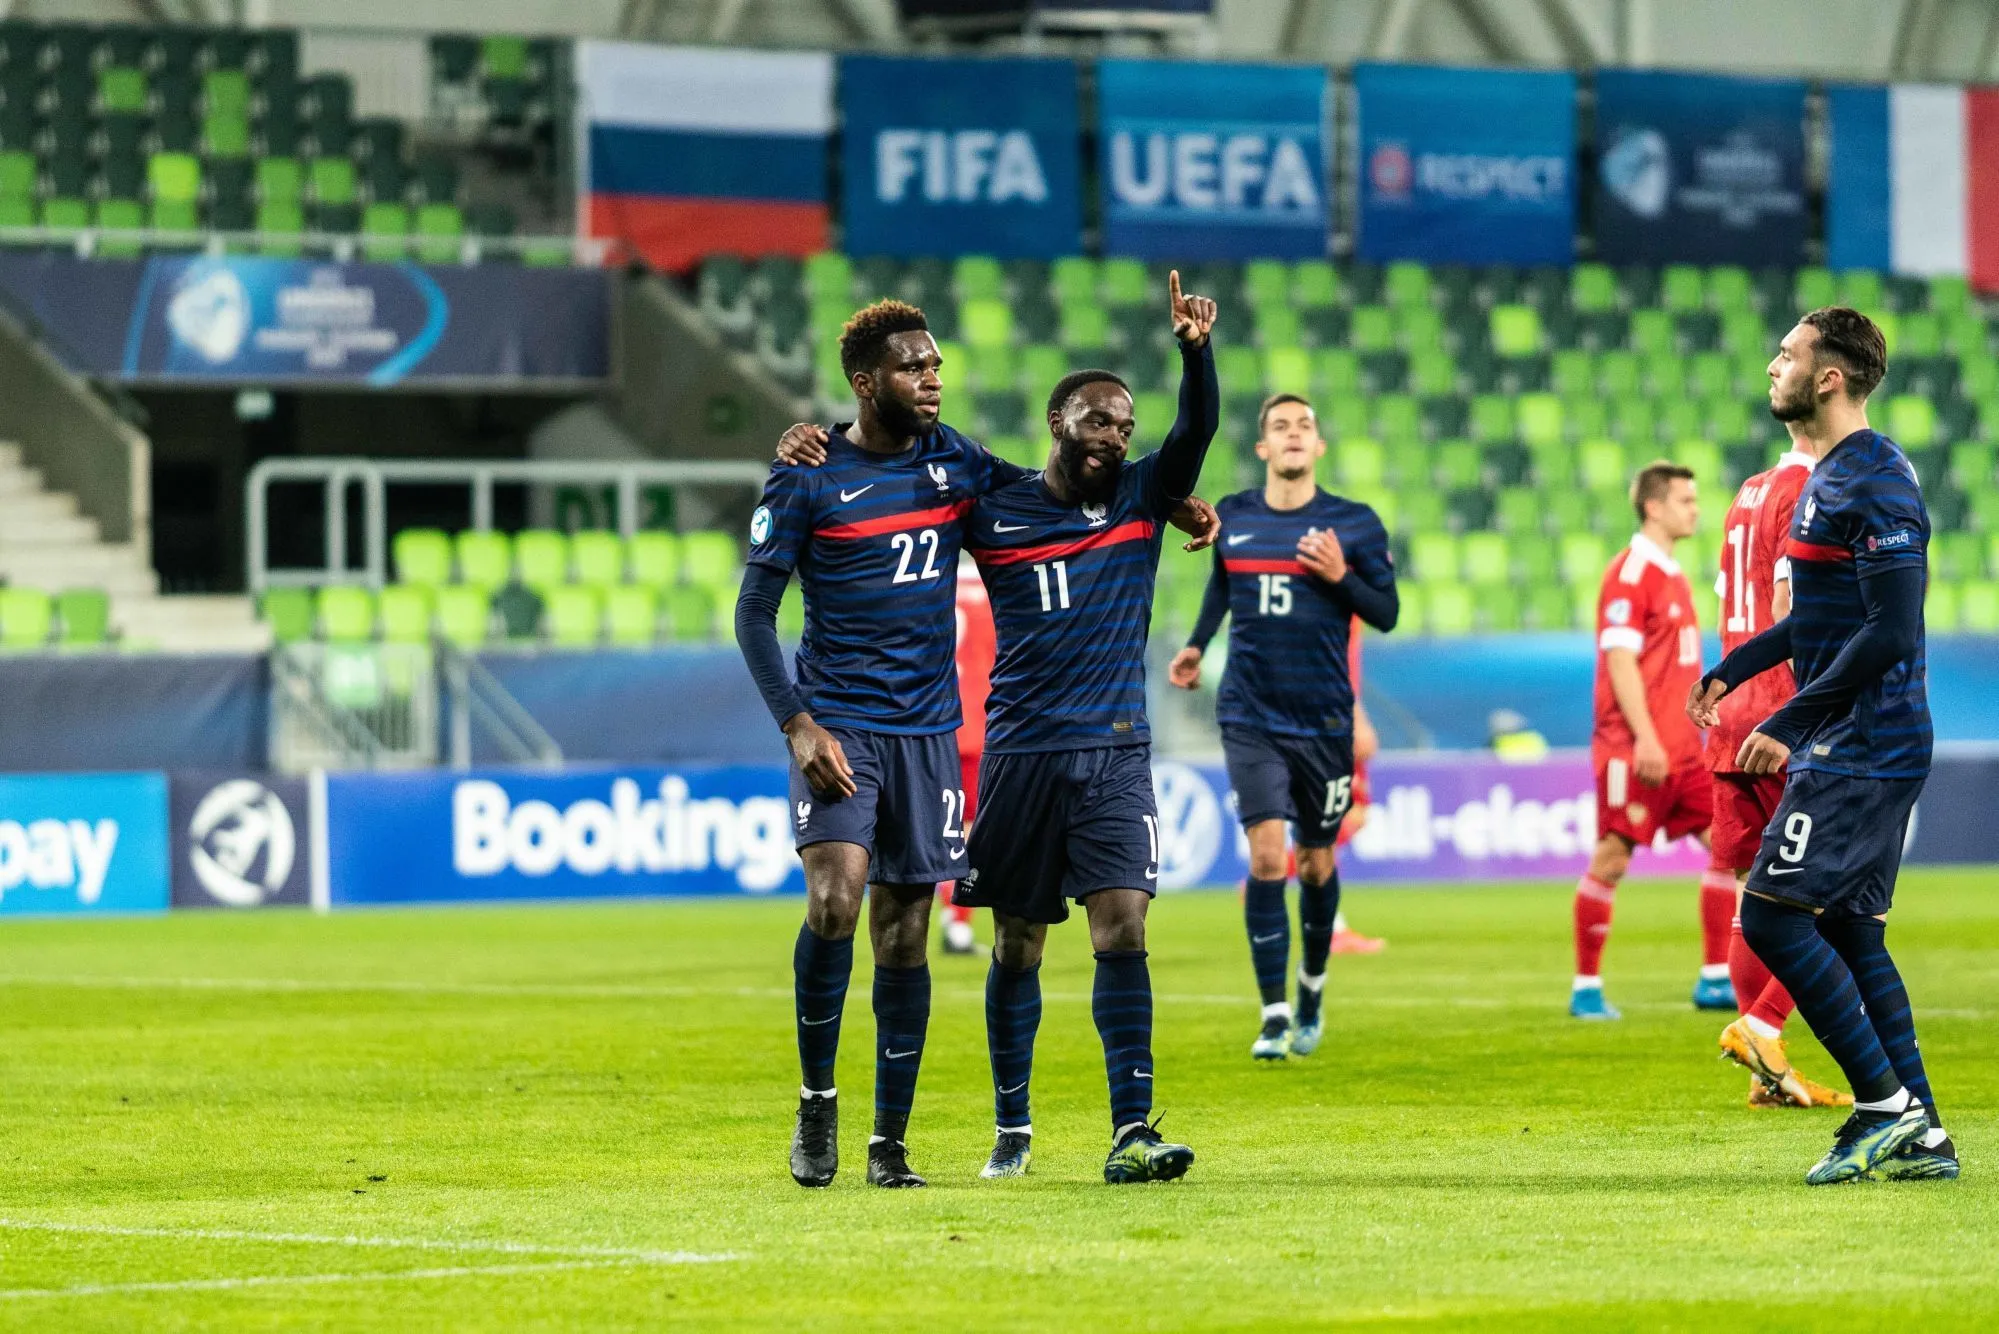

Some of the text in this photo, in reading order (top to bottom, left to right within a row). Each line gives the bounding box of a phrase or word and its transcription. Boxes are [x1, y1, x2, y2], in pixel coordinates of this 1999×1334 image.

[876, 130, 1047, 202] FIFA
[1110, 131, 1320, 214] UEFA
[891, 529, 941, 583] 22
[1877, 533, 1909, 547] RESPECT
[1033, 560, 1070, 611] 11
[1258, 574, 1293, 615] 15
[1324, 775, 1351, 816] 15
[1780, 811, 1812, 863] 9
